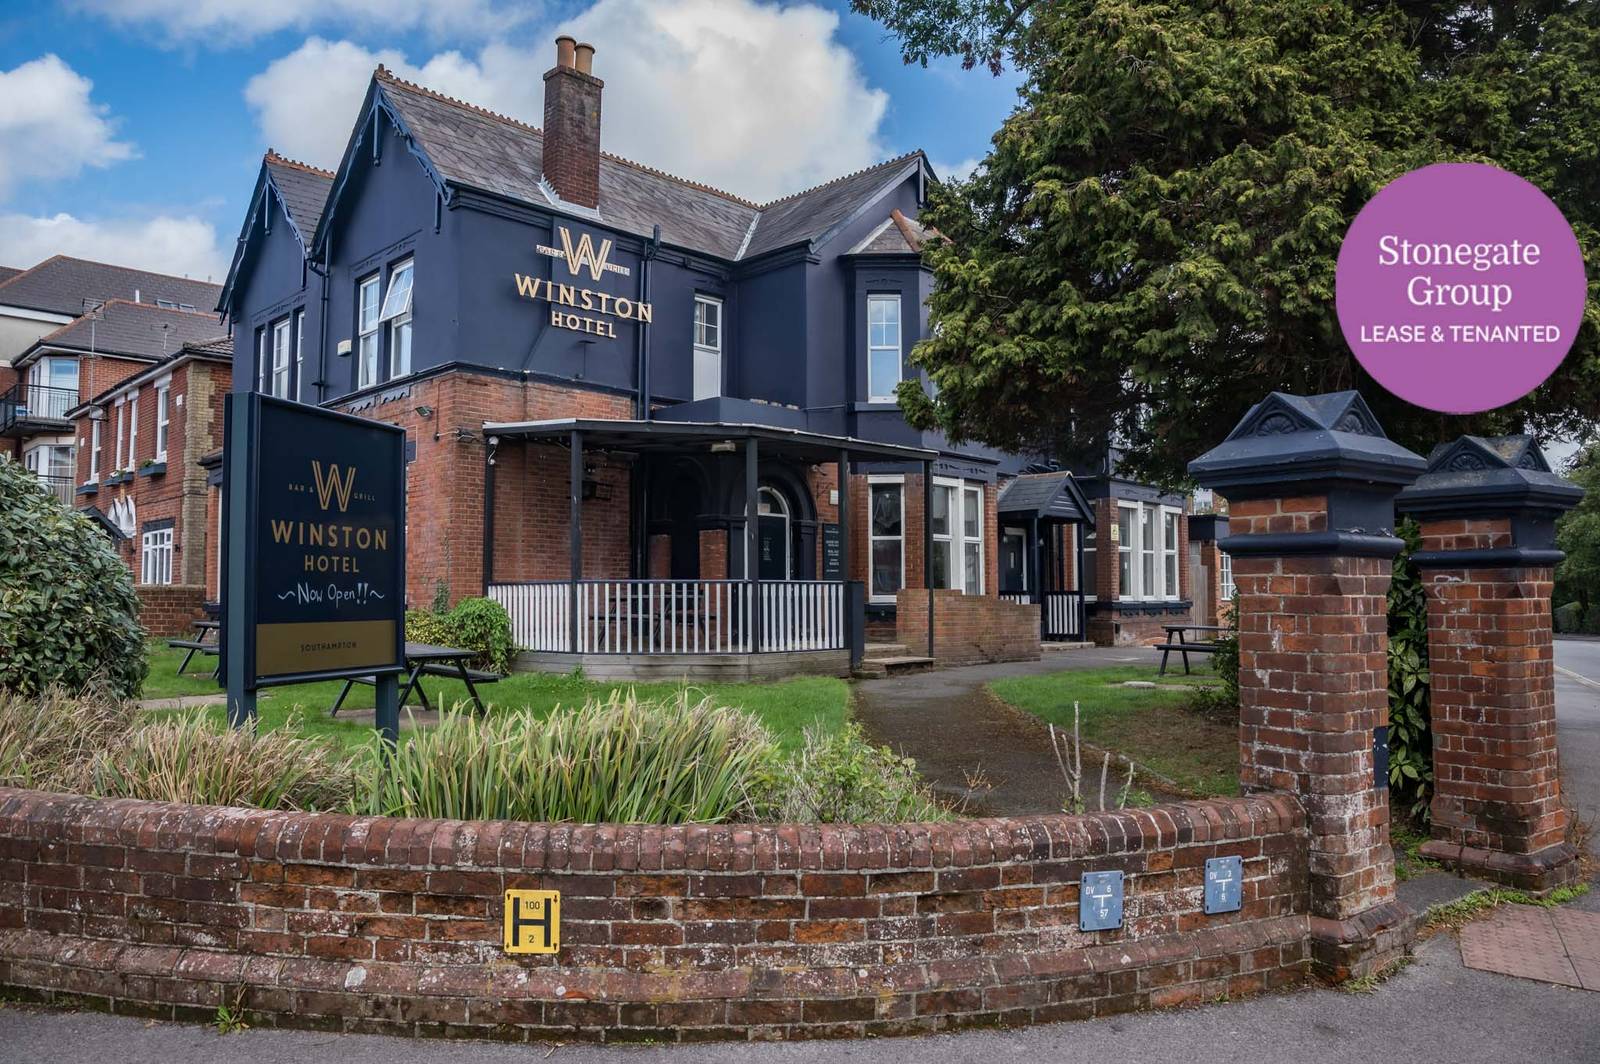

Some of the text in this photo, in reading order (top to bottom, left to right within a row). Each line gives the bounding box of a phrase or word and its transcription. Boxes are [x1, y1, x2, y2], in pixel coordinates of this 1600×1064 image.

[559, 226, 612, 280] W
[515, 273, 652, 323] WINSTON
[551, 310, 617, 339] HOTEL
[312, 460, 356, 512] W
[271, 519, 387, 550] WINSTON
[304, 555, 360, 573] HOTEL
[297, 582, 323, 605] Now
[300, 641, 357, 653] SOUTHAMPTON
[1106, 885, 1112, 893] 6
[525, 901, 540, 910] 100
[1099, 909, 1109, 919] 57
[528, 935, 535, 943] 2
